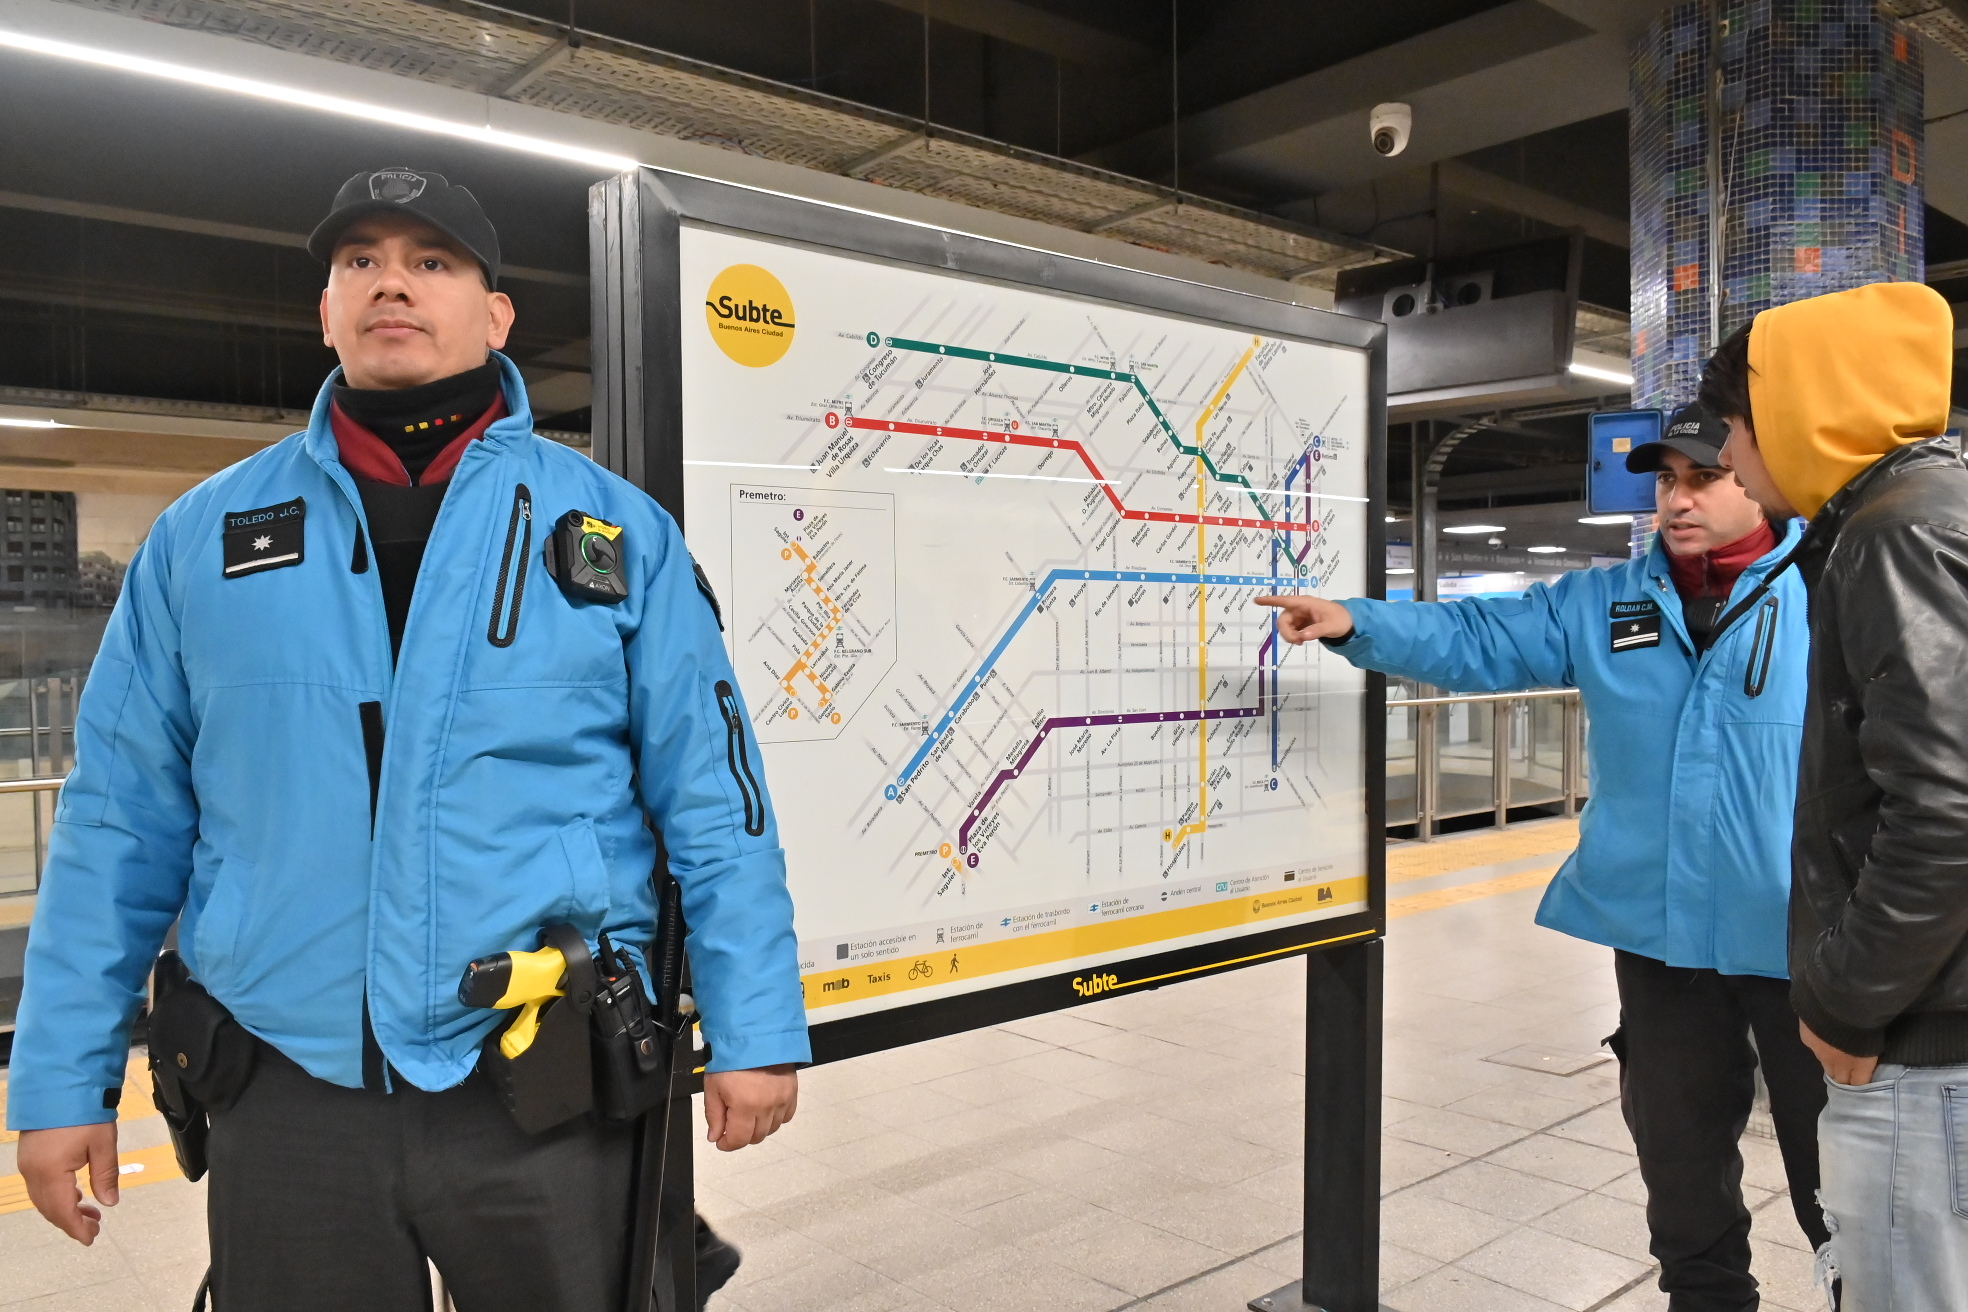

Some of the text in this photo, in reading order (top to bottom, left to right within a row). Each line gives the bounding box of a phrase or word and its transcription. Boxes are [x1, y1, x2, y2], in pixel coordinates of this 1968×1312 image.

[381, 173, 417, 181] POLICIA
[713, 296, 789, 327] Subte
[718, 323, 783, 337] Buenos Aires Ciudad
[868, 350, 893, 376] Congreso
[921, 357, 944, 383] Juramento
[983, 363, 993, 376] José
[868, 356, 898, 390] de Tucumán
[974, 369, 996, 395] Hernández
[1119, 385, 1133, 404] Palermo
[1091, 403, 1103, 419] Miguel
[1126, 402, 1145, 426] Plaza Italia
[1671, 422, 1700, 431] POLICIA
[816, 428, 849, 466] Juan Manuel
[831, 435, 855, 461] de Rosas
[867, 434, 892, 461] Echeverría
[914, 439, 939, 468] De los Incas
[932, 444, 944, 459] Chas
[966, 443, 985, 465] Tronador
[991, 446, 1008, 463] Lacroze
[826, 442, 859, 478] Villa Urquiza
[1038, 451, 1054, 471] Dorrego
[739, 490, 786, 501] Premetro:
[229, 512, 274, 527] TOLEDO
[1041, 586, 1057, 606] Primera
[1073, 582, 1087, 601] Acoyte
[788, 605, 801, 620] Cecilia
[792, 627, 808, 646] Escalada
[792, 644, 800, 655] Pola
[980, 675, 992, 689] Puan
[765, 712, 778, 726] Centro
[779, 701, 793, 718] Lugano
[818, 702, 832, 720] General
[825, 706, 835, 719] Savio
[954, 699, 975, 724] Carabobo
[1111, 726, 1121, 740] Plata
[1150, 725, 1162, 741] Boedo
[931, 734, 949, 758] San José
[935, 737, 954, 763] de Flores
[1006, 740, 1023, 761] Medalla
[1009, 739, 1030, 765] Milagrosa
[900, 760, 930, 797] San Pedrito
[967, 791, 982, 809] Varela
[968, 817, 988, 843] Plaza de
[972, 812, 1000, 849] los Virreyes
[976, 822, 1000, 853] Eva Perón
[1167, 843, 1186, 872] Hospitales
[937, 871, 956, 897] Saguier
[1102, 899, 1122, 908] Estación
[1013, 907, 1070, 923] Estación de trasbordo
[950, 924, 975, 934] Estación
[1013, 919, 1057, 932] con el ferrocarril
[850, 941, 877, 951] Estación
[878, 936, 906, 946] accesible
[950, 932, 978, 943] ferrocarril
[850, 946, 899, 961] un solo sentido
[867, 972, 891, 984] Taxis
[1073, 973, 1118, 997] Subte
